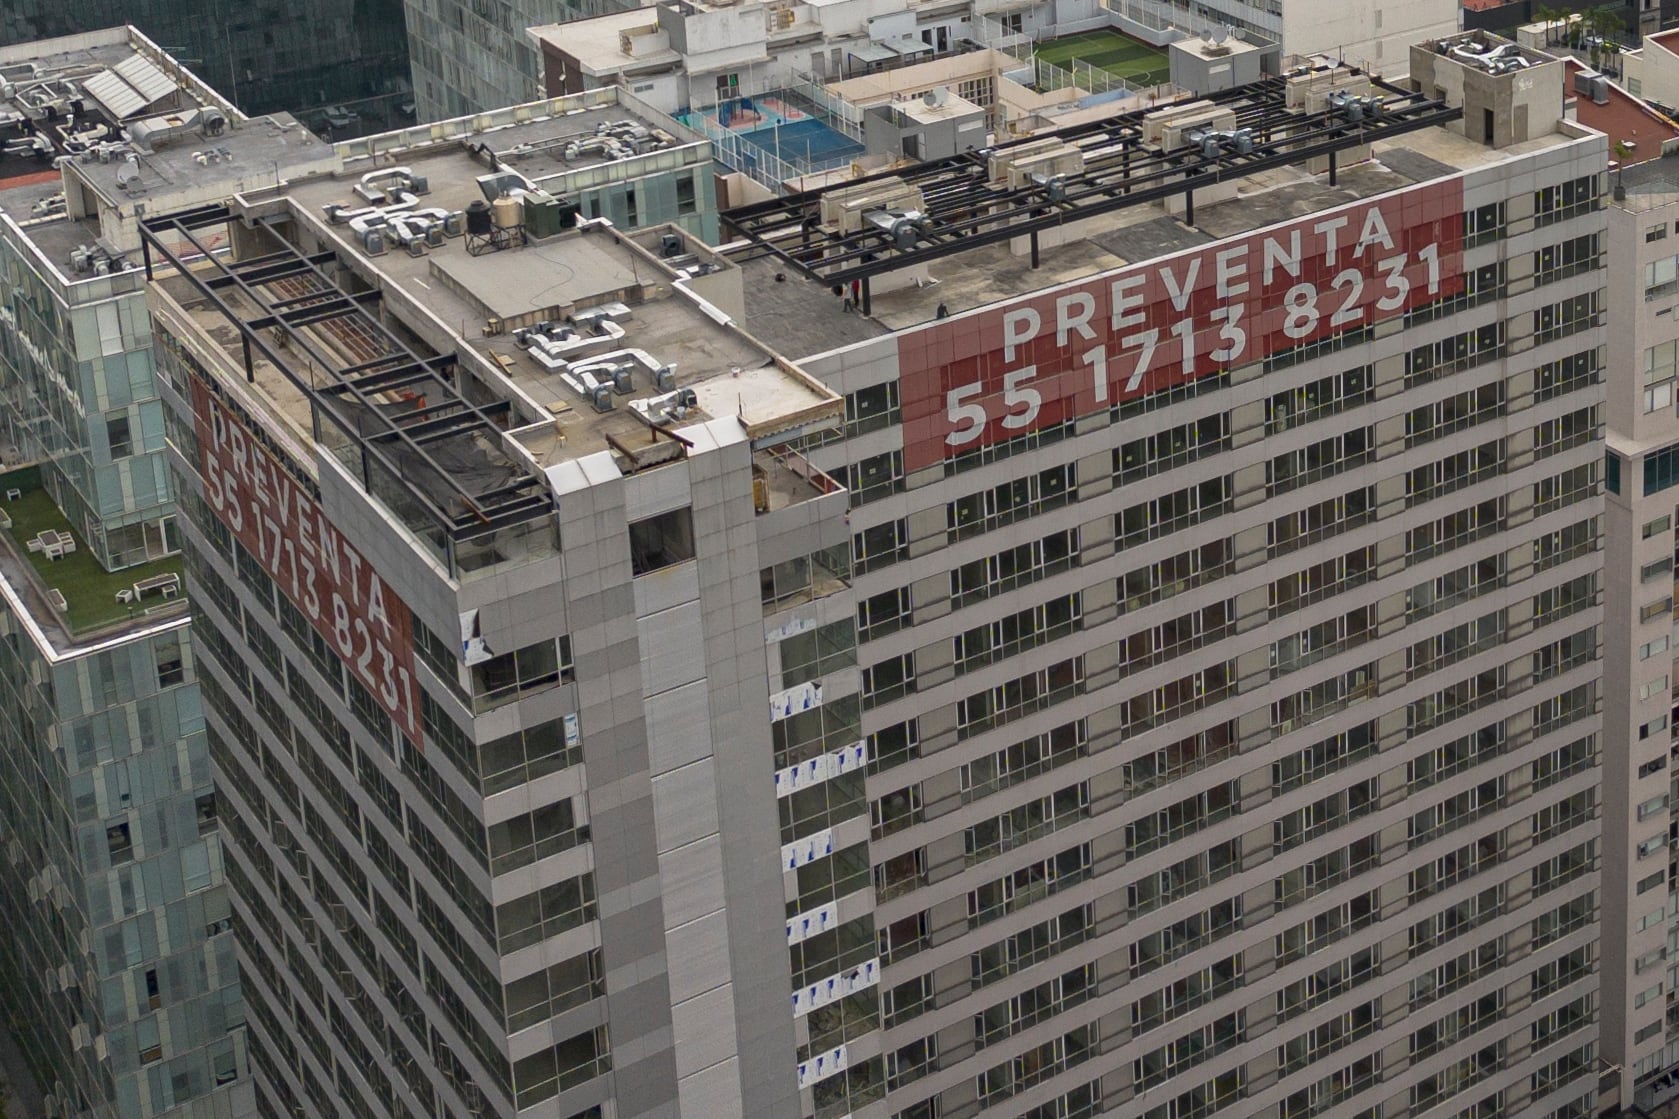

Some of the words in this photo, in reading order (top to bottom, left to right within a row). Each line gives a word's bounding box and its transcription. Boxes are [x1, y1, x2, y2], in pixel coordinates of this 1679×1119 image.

[944, 364, 1042, 446] 55
[1082, 303, 1246, 403] 1713
[1282, 242, 1440, 339] 8231
[1003, 206, 1395, 363] PREVENTA
[206, 449, 243, 532] 55
[251, 501, 321, 621] 1713
[332, 592, 415, 735] 8231
[208, 398, 392, 642] PREVENTA
